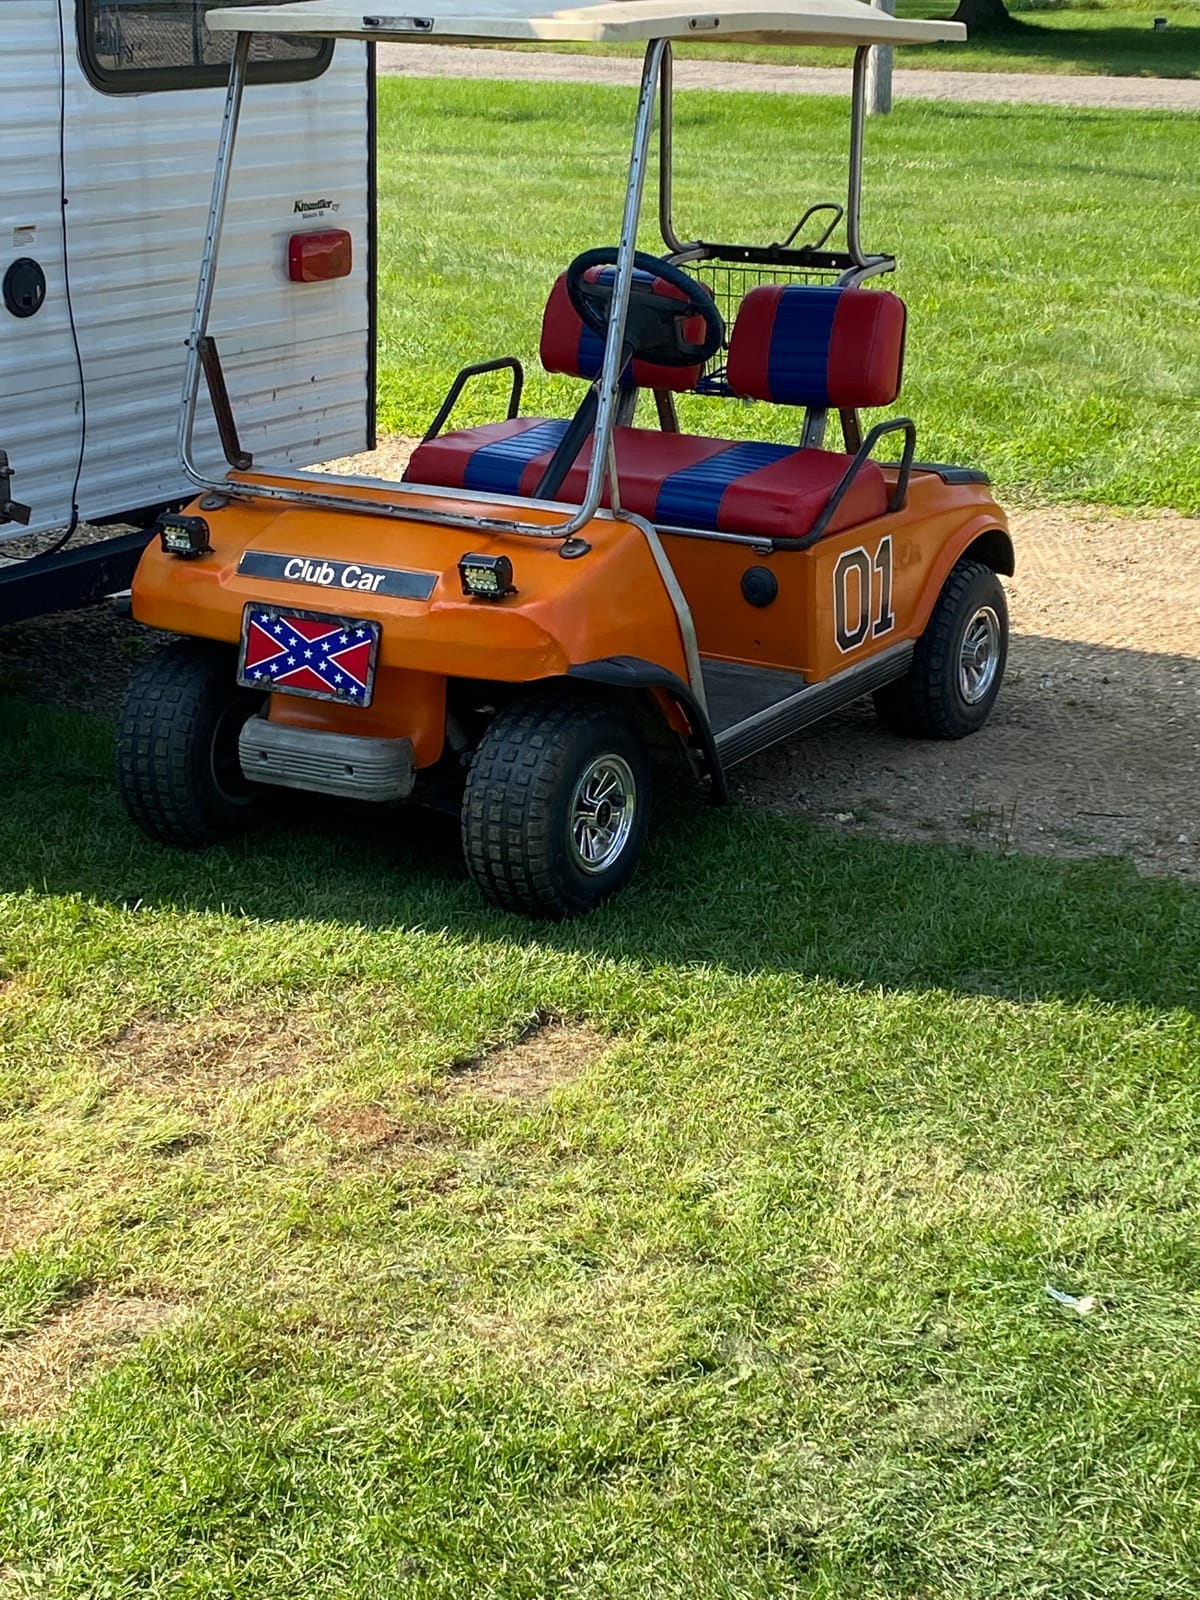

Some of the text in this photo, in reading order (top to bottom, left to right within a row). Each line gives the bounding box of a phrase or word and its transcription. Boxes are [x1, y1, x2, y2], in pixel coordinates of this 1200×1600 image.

[284, 558, 386, 592] Club Car
[833, 534, 895, 654] 01
